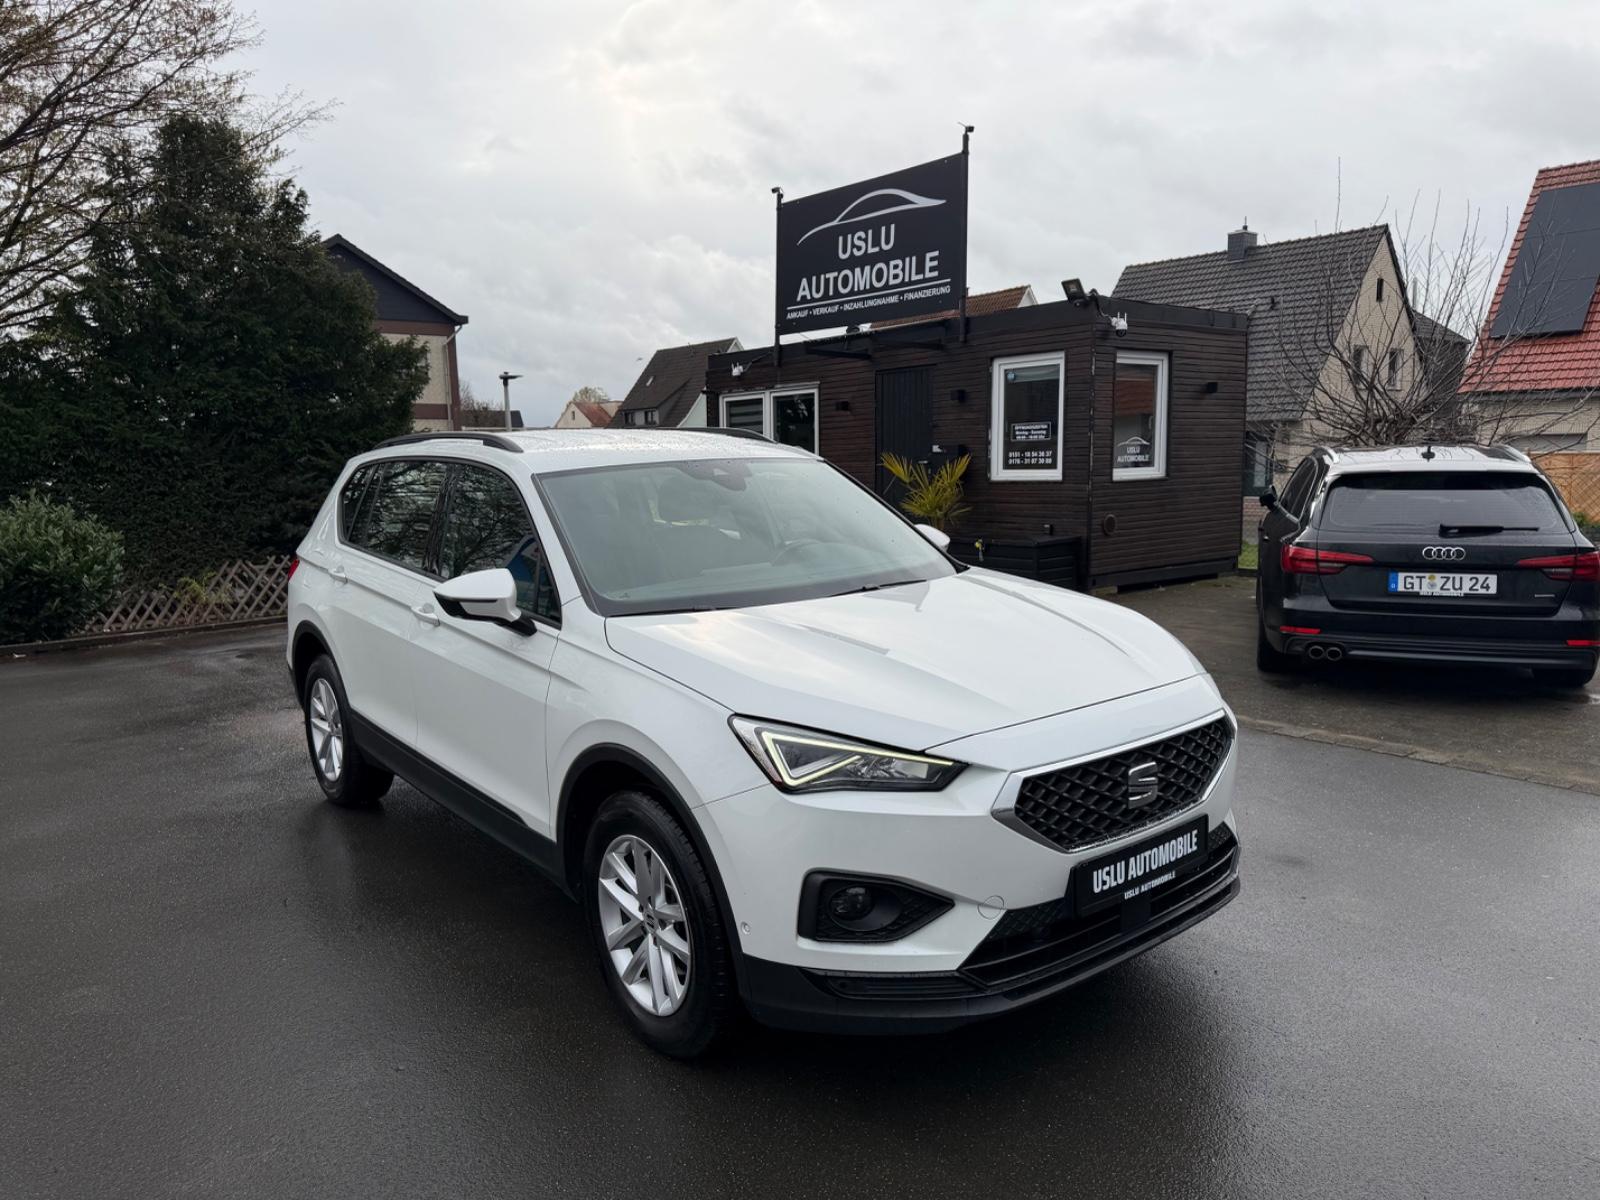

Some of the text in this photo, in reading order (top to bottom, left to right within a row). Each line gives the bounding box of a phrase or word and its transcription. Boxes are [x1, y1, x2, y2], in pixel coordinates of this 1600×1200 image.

[838, 224, 895, 260] USLU
[797, 251, 939, 302] AUTOMOBILE
[786, 285, 951, 320] ANKAUF VERKAUF INZAHLUNGNAHME FINANZIERUNG
[1403, 575, 1491, 592] GT ZU 24
[1093, 829, 1198, 894] USLU AUTOMOBILE
[1124, 871, 1176, 900] USLU AUTOMOBILE
